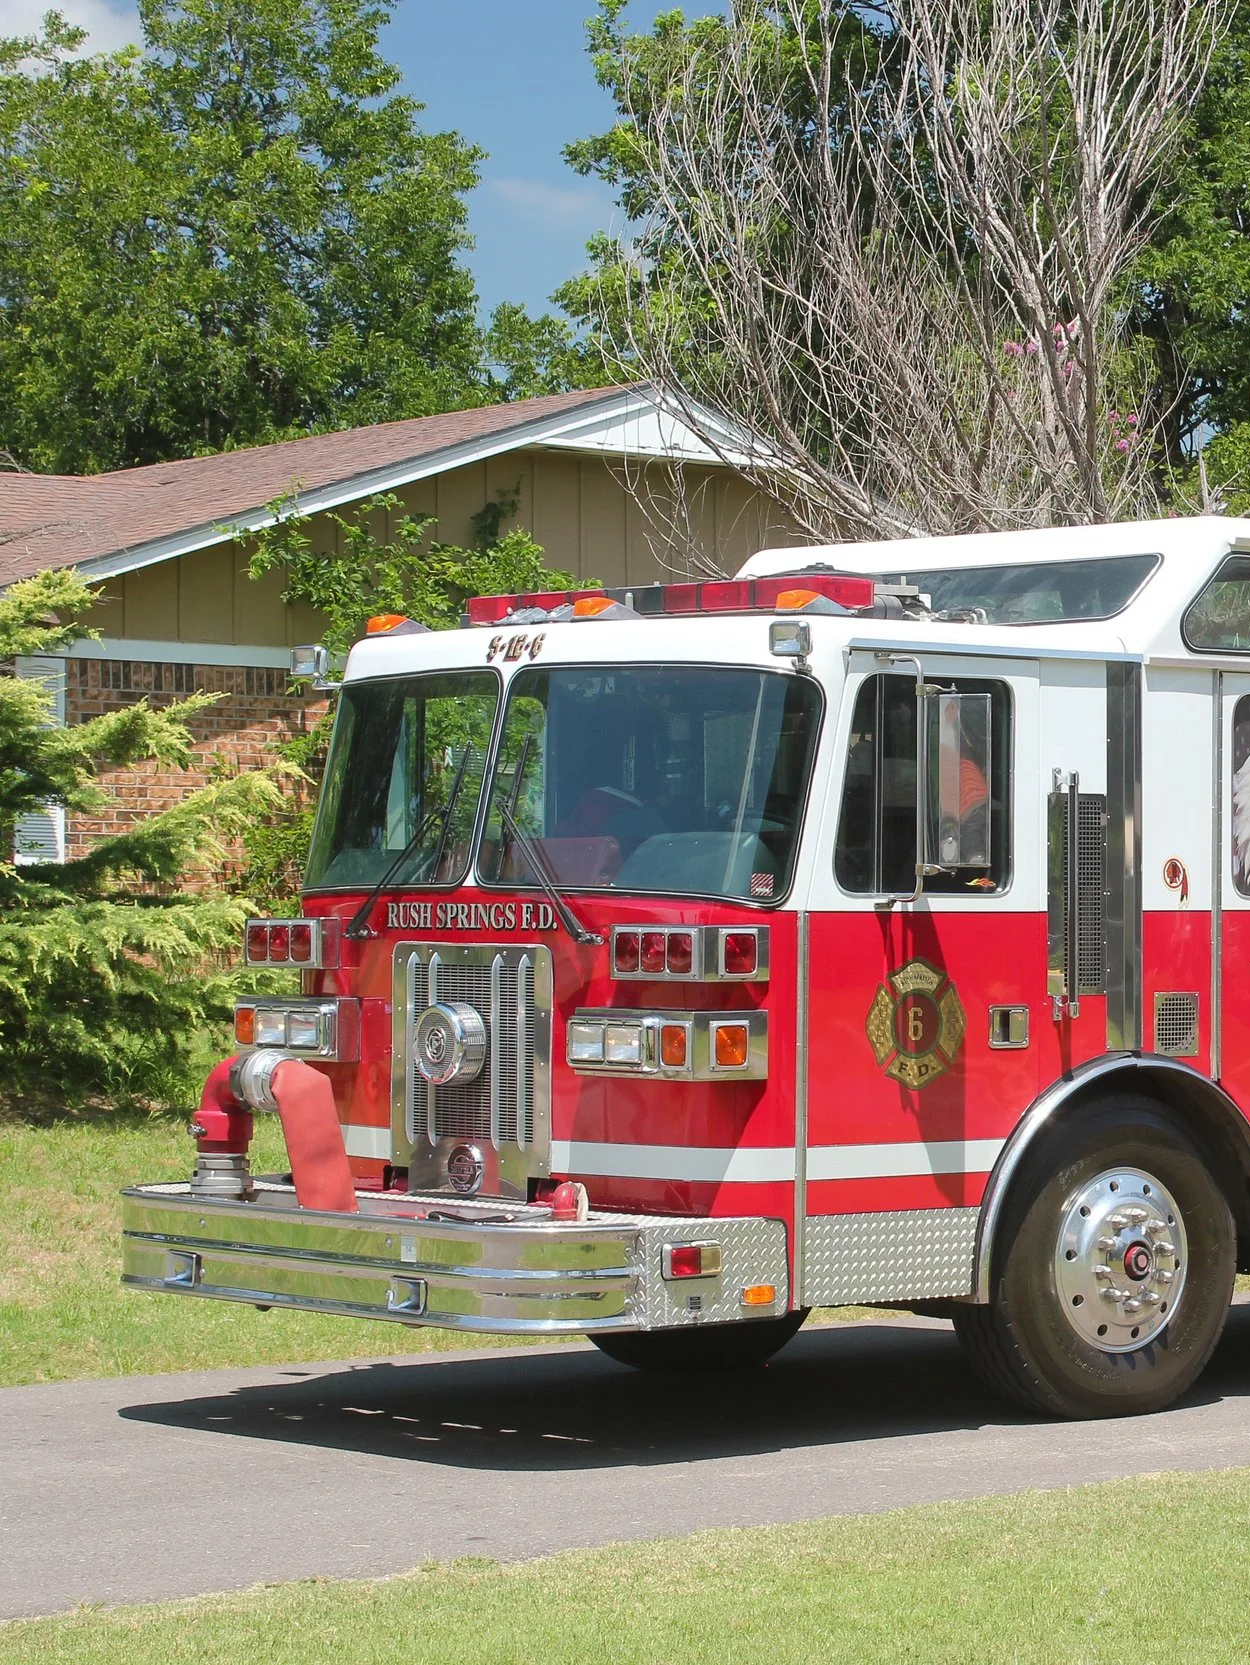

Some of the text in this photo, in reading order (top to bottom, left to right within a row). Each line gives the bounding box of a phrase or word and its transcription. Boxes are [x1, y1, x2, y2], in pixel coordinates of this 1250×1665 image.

[387, 902, 558, 931] RUSH SPRINGS F.D.
[908, 1007, 922, 1041] 6
